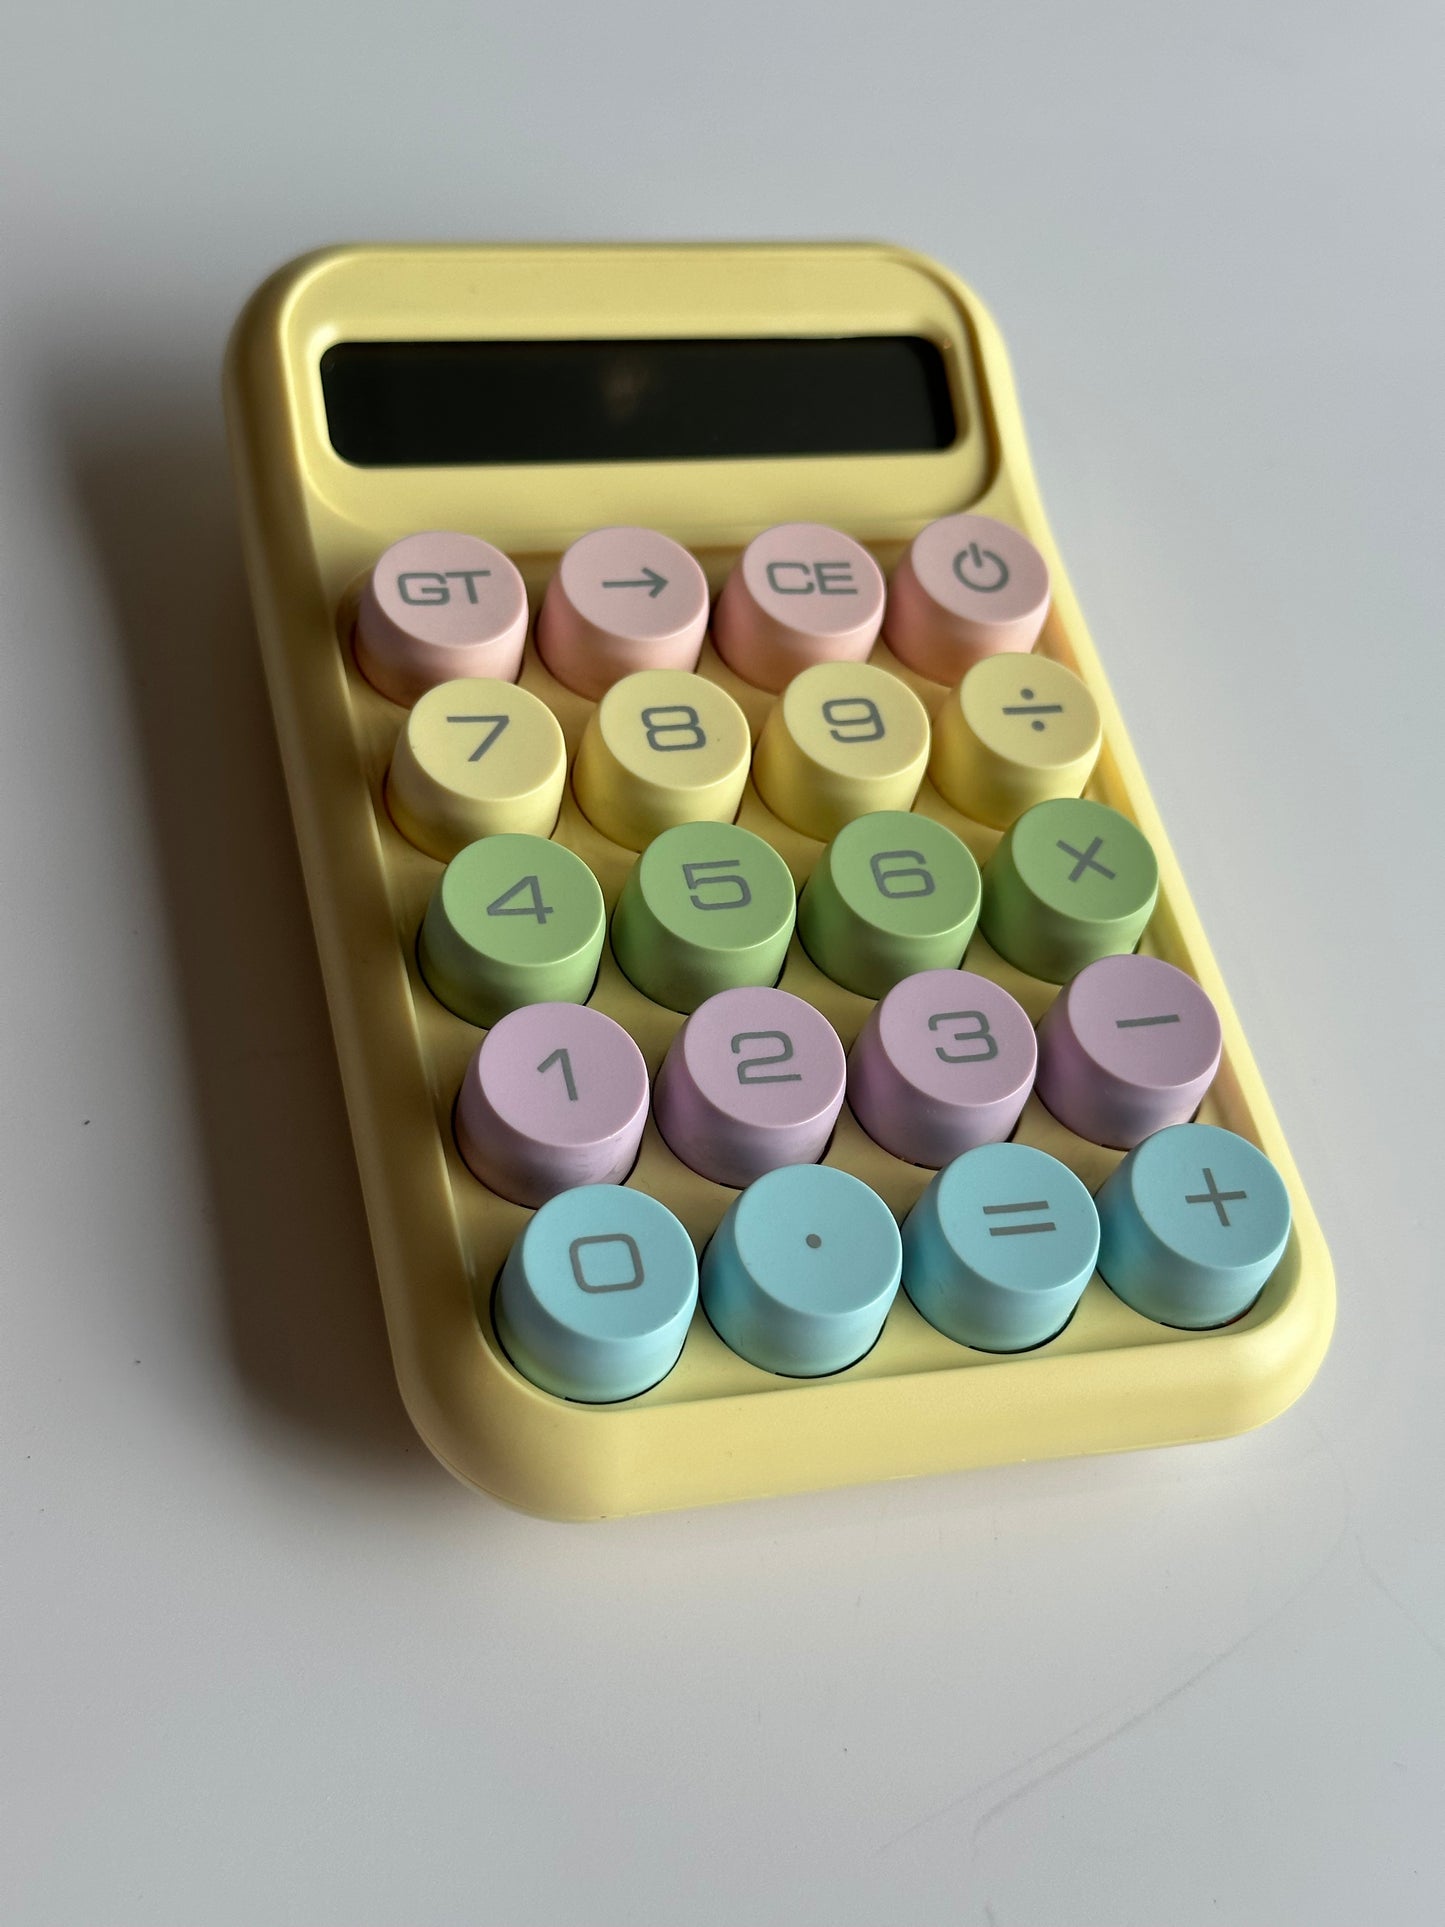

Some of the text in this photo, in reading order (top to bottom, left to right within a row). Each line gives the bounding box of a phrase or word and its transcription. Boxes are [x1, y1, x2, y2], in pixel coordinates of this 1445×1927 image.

[398, 570, 491, 605] GT
[767, 562, 858, 595] CE
[447, 715, 509, 762] 7
[641, 706, 706, 751] 8
[822, 698, 885, 743] 9
[682, 860, 751, 910] 5
[870, 850, 935, 899] 6
[487, 876, 554, 924] 4
[731, 1031, 802, 1084] 2
[928, 1011, 998, 1063] 3
[537, 1049, 578, 1101] 1
[983, 1201, 1056, 1236] =
[1185, 1168, 1247, 1227] +
[569, 1234, 644, 1294] 0
